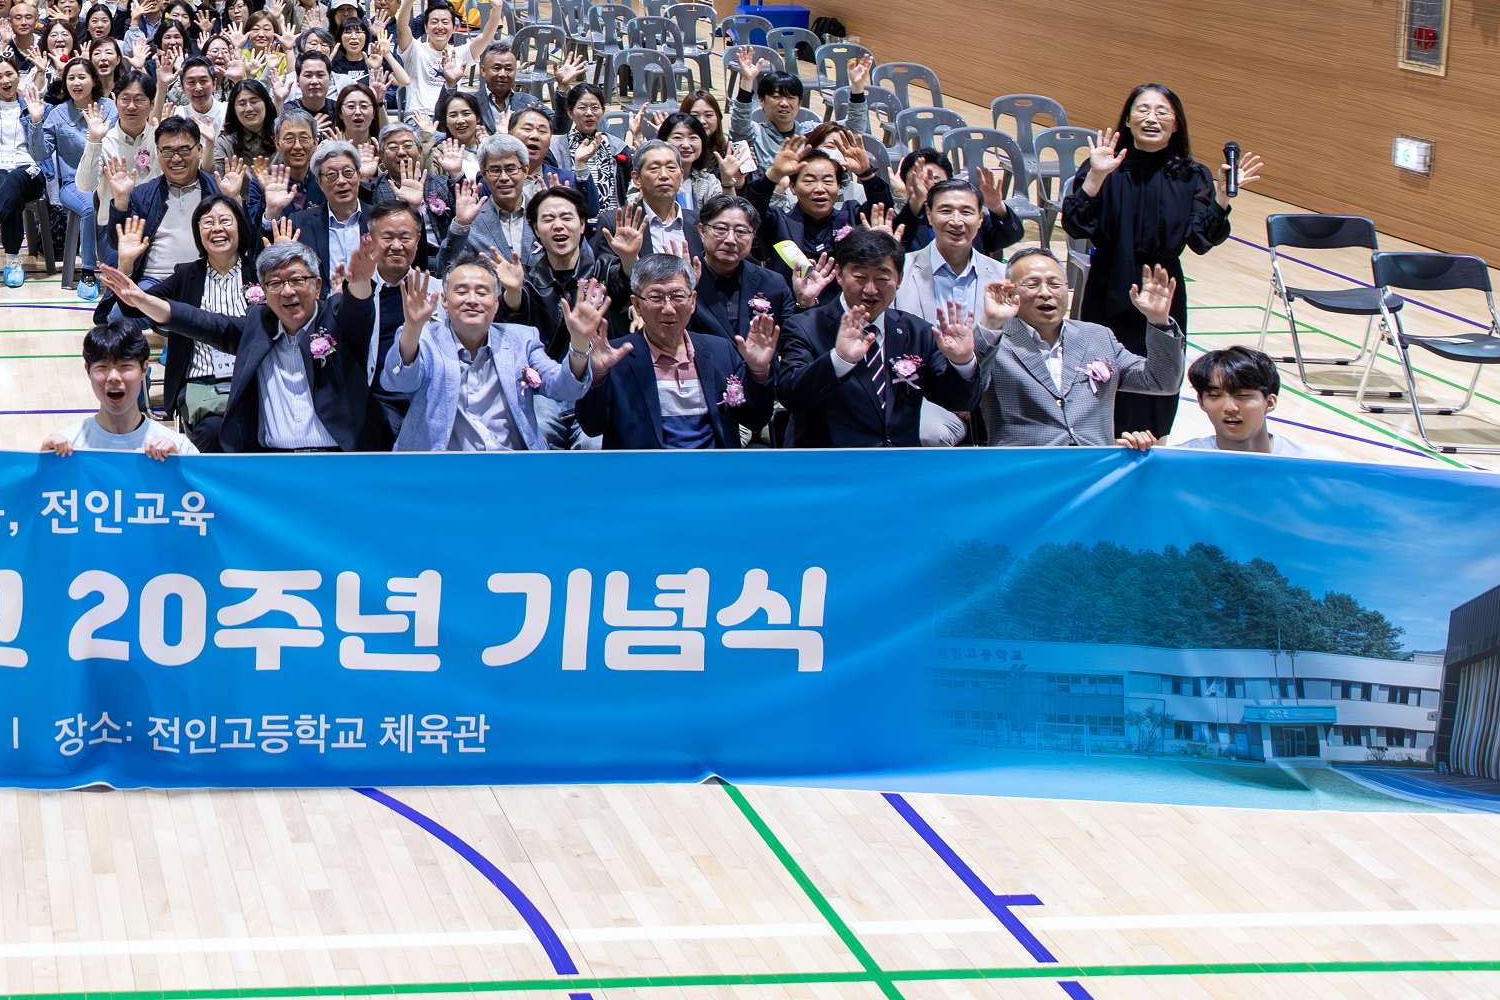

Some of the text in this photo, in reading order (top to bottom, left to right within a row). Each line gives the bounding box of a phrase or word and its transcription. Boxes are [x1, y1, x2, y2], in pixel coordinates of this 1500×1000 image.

[41, 489, 215, 536] 전인교육
[68, 568, 442, 672] 20주년
[481, 566, 827, 672] 기념식
[55, 712, 132, 756] 장소:
[148, 714, 367, 754] 전인고등학교
[379, 713, 490, 754] 체육관
